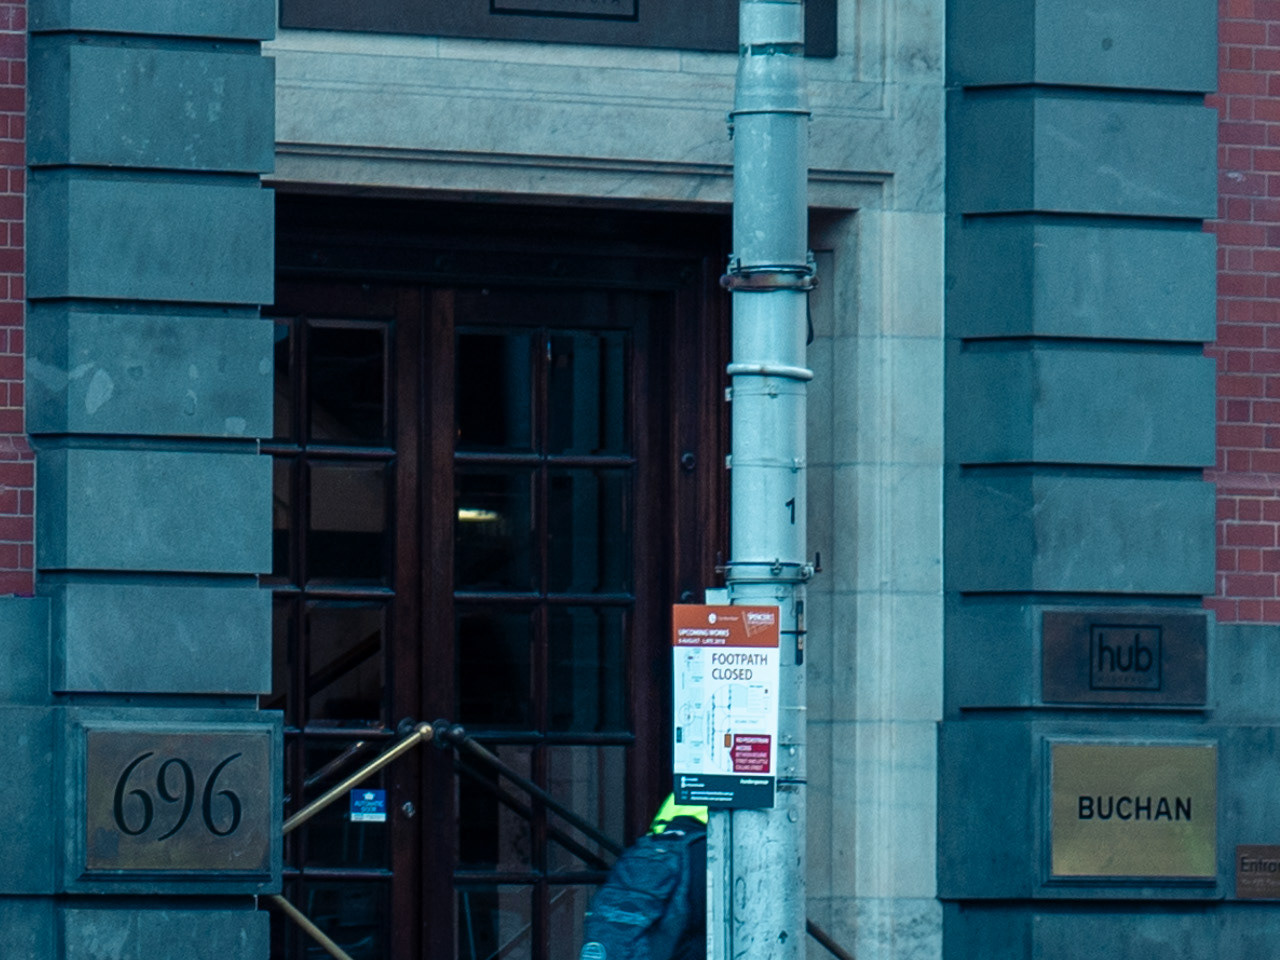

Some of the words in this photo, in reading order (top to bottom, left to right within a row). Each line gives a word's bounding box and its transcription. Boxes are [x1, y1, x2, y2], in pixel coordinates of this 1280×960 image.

[711, 653, 768, 665] FOOTPATH
[1098, 632, 1153, 672] hub
[711, 668, 753, 680] CLOSED
[113, 752, 242, 842] 696
[1078, 796, 1192, 820] BUCHAN
[1240, 856, 1280, 873] Entra
